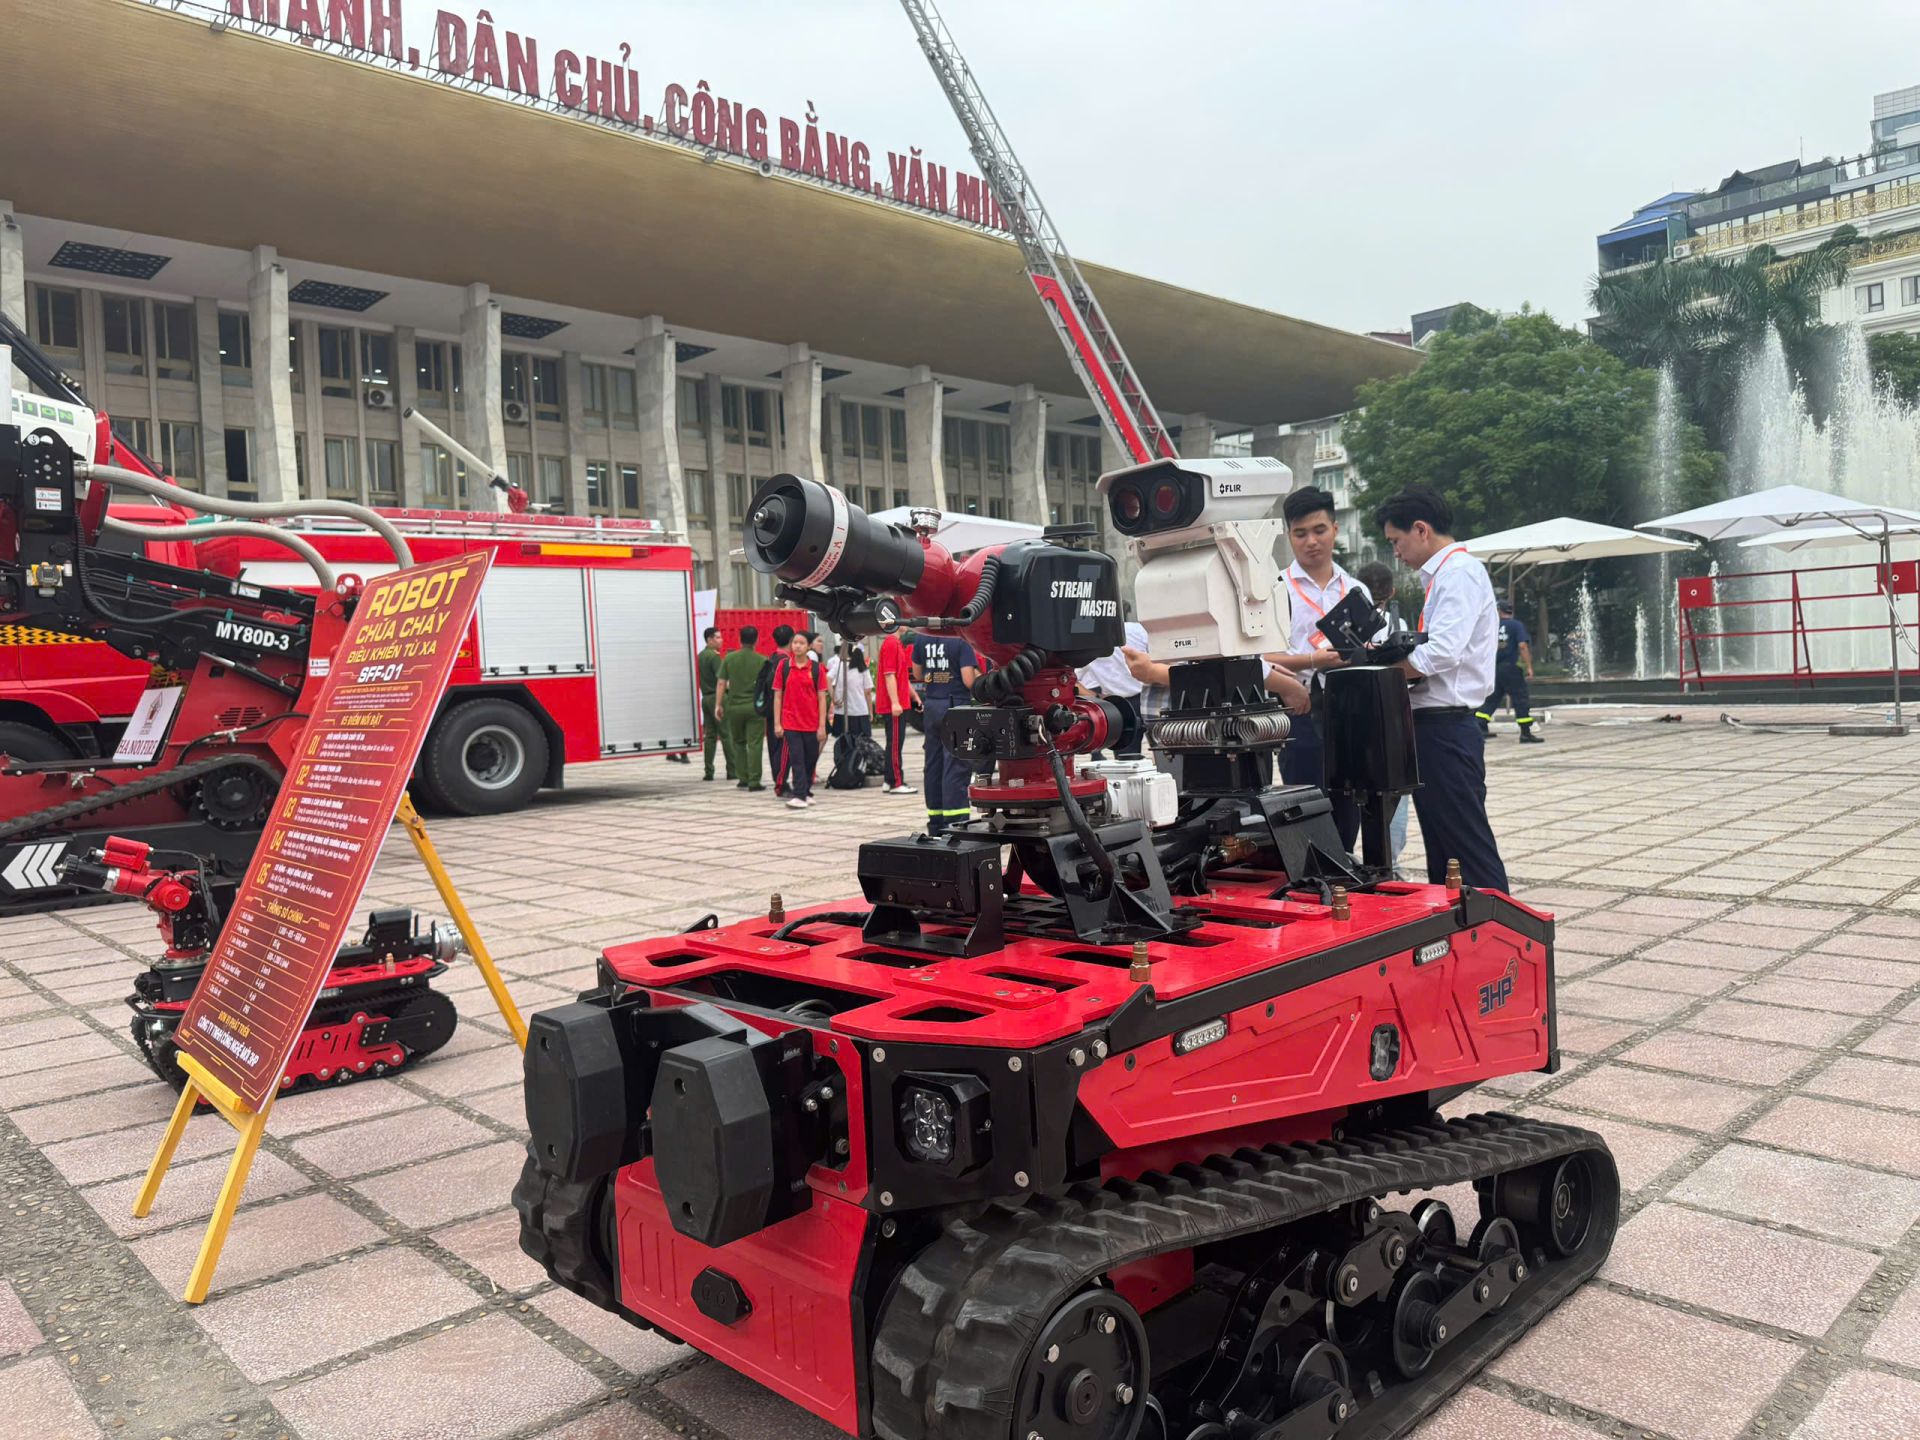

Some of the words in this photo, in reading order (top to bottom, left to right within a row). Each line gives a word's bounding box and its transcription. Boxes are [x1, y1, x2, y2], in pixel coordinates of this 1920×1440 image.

[437, 9, 540, 99] DÂN
[554, 42, 654, 136] CHỦ,
[665, 80, 769, 161] CÔNG
[780, 100, 883, 200] BẰNG,
[888, 145, 947, 213] VĂN
[1225, 484, 1241, 493] FLIR
[366, 567, 469, 619] ROBOT
[1050, 580, 1093, 599] STREAM
[1079, 599, 1117, 617] MASTER
[399, 607, 451, 638] CHÁY
[216, 621, 290, 651] MY80D-3
[421, 640, 438, 655] XA
[925, 643, 945, 658] 114
[357, 663, 404, 684] SFF-01
[295, 765, 309, 784] 02
[282, 797, 296, 817] 03
[270, 830, 284, 850] 04
[1479, 976, 1512, 1016] 3HP
